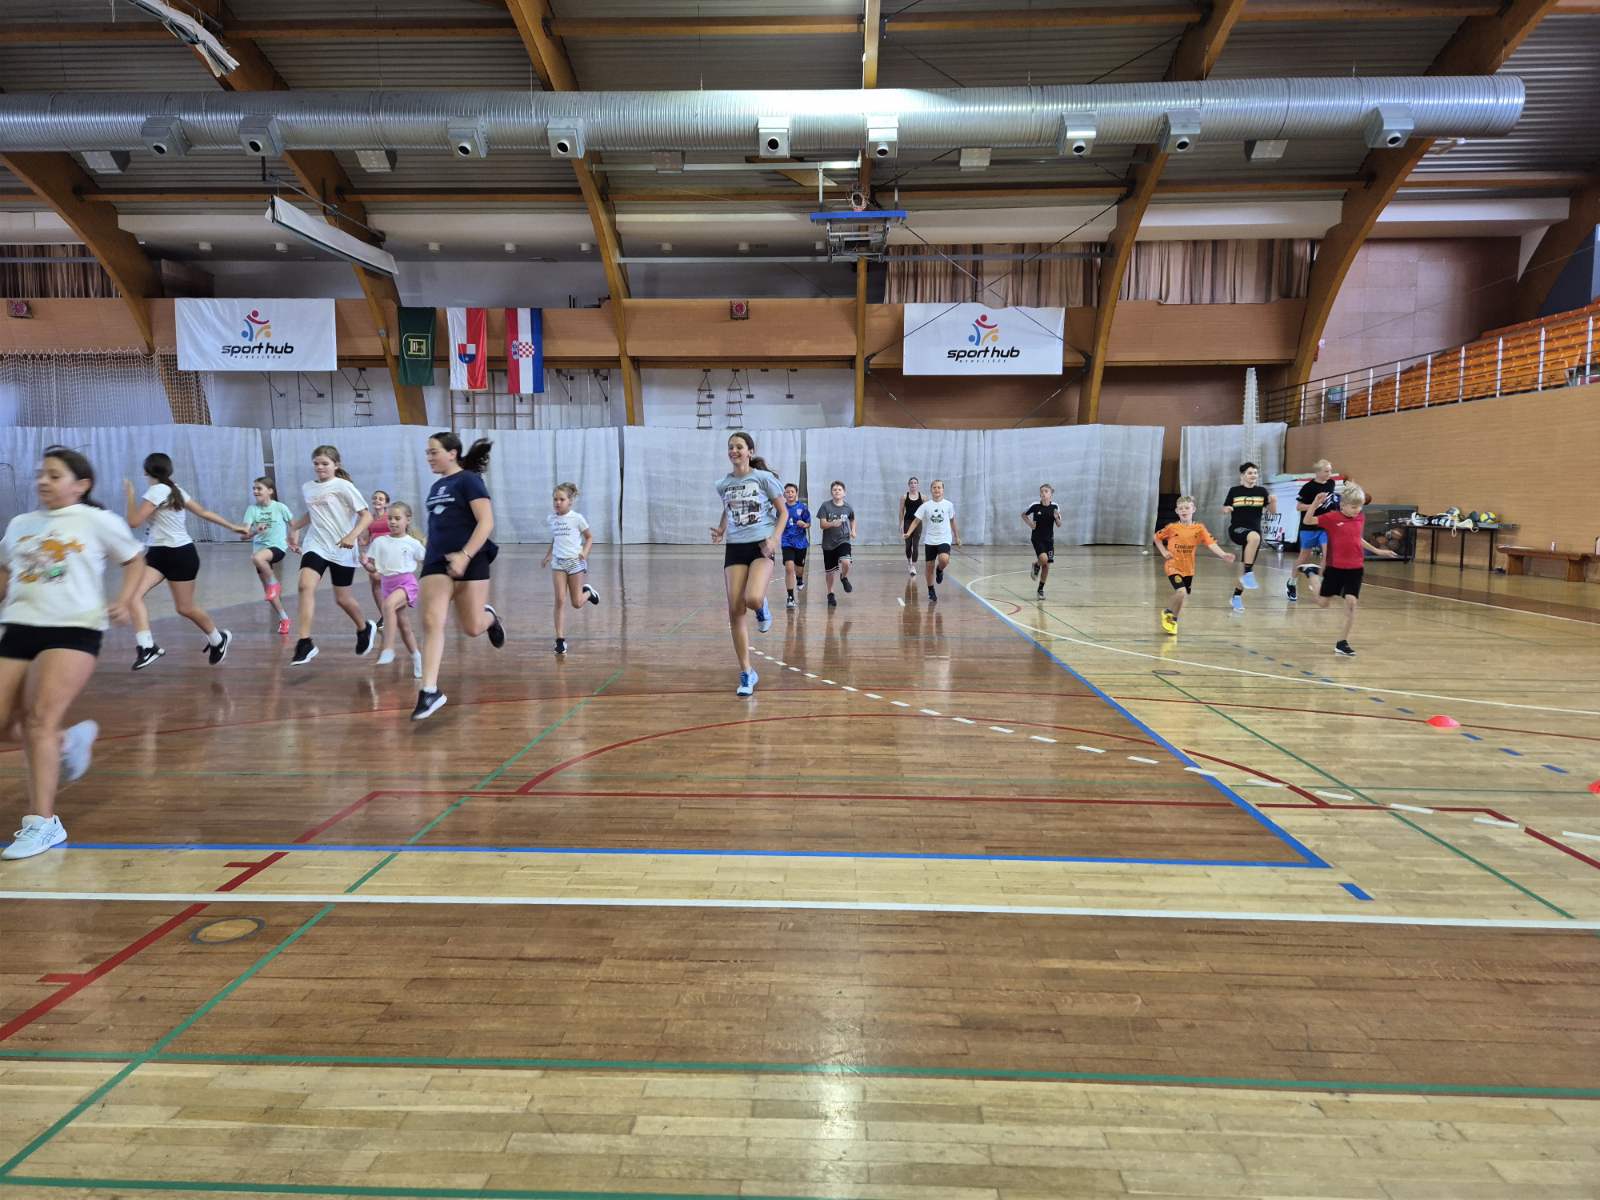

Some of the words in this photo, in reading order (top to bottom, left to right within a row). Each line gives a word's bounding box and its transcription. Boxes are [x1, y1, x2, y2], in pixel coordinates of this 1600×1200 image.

[221, 342, 263, 357] sport
[265, 342, 294, 354] hub
[947, 346, 989, 361] sport
[991, 346, 1020, 358] hub
